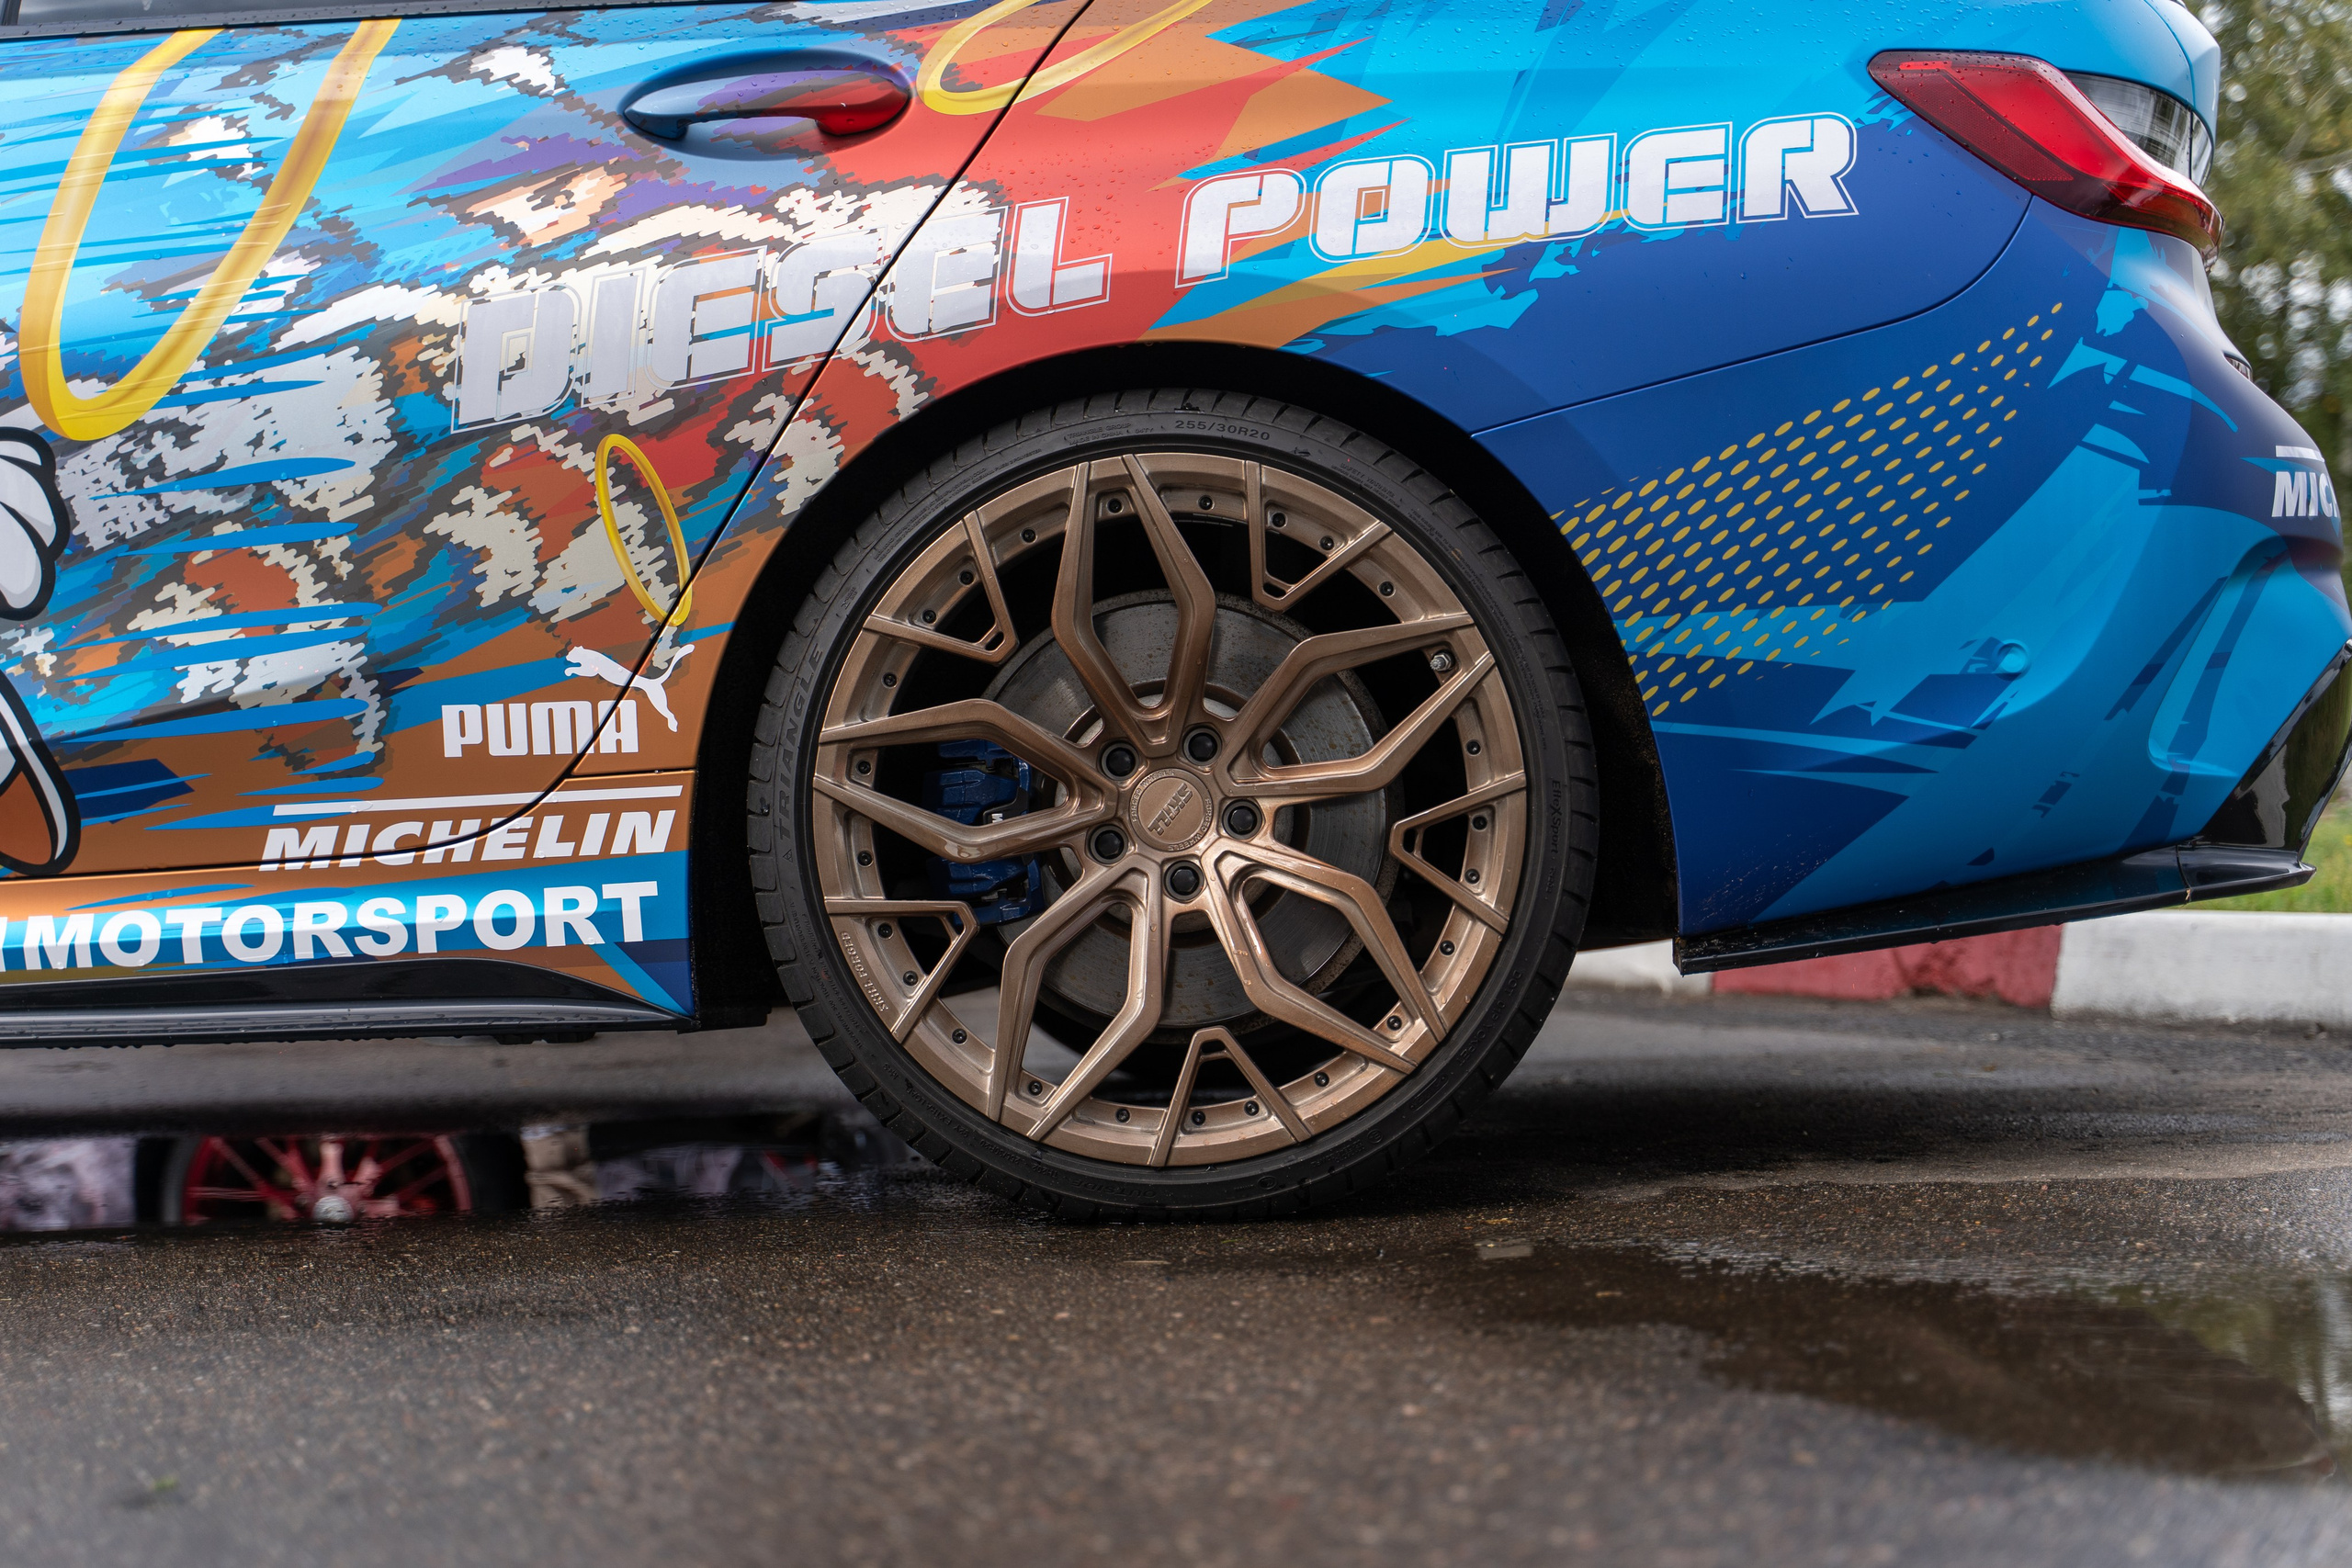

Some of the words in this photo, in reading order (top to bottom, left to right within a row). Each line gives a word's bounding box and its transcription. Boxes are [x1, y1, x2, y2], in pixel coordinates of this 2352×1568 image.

[450, 196, 1114, 434] DIESEL
[1175, 111, 1860, 288] POWER
[1067, 425, 1102, 439] TRIANGLE
[1104, 422, 1131, 431] GROUP
[1174, 419, 1271, 441] 255/30R20
[442, 700, 639, 758] PUMA
[778, 642, 826, 840] TRIANGLE
[1148, 783, 1193, 836] SKILL
[1199, 796, 1213, 833] FORGED
[258, 809, 676, 872] MICHELIN
[1167, 830, 1204, 851] WHEELS
[23, 880, 659, 970] MOTORSPORT
[840, 931, 868, 978] FORGED
[865, 979, 889, 1012] SKILL
[1501, 968, 1522, 997] DOT
[922, 1100, 953, 1127] EXTRA
[1069, 1178, 1157, 1200] OUTSIDE
